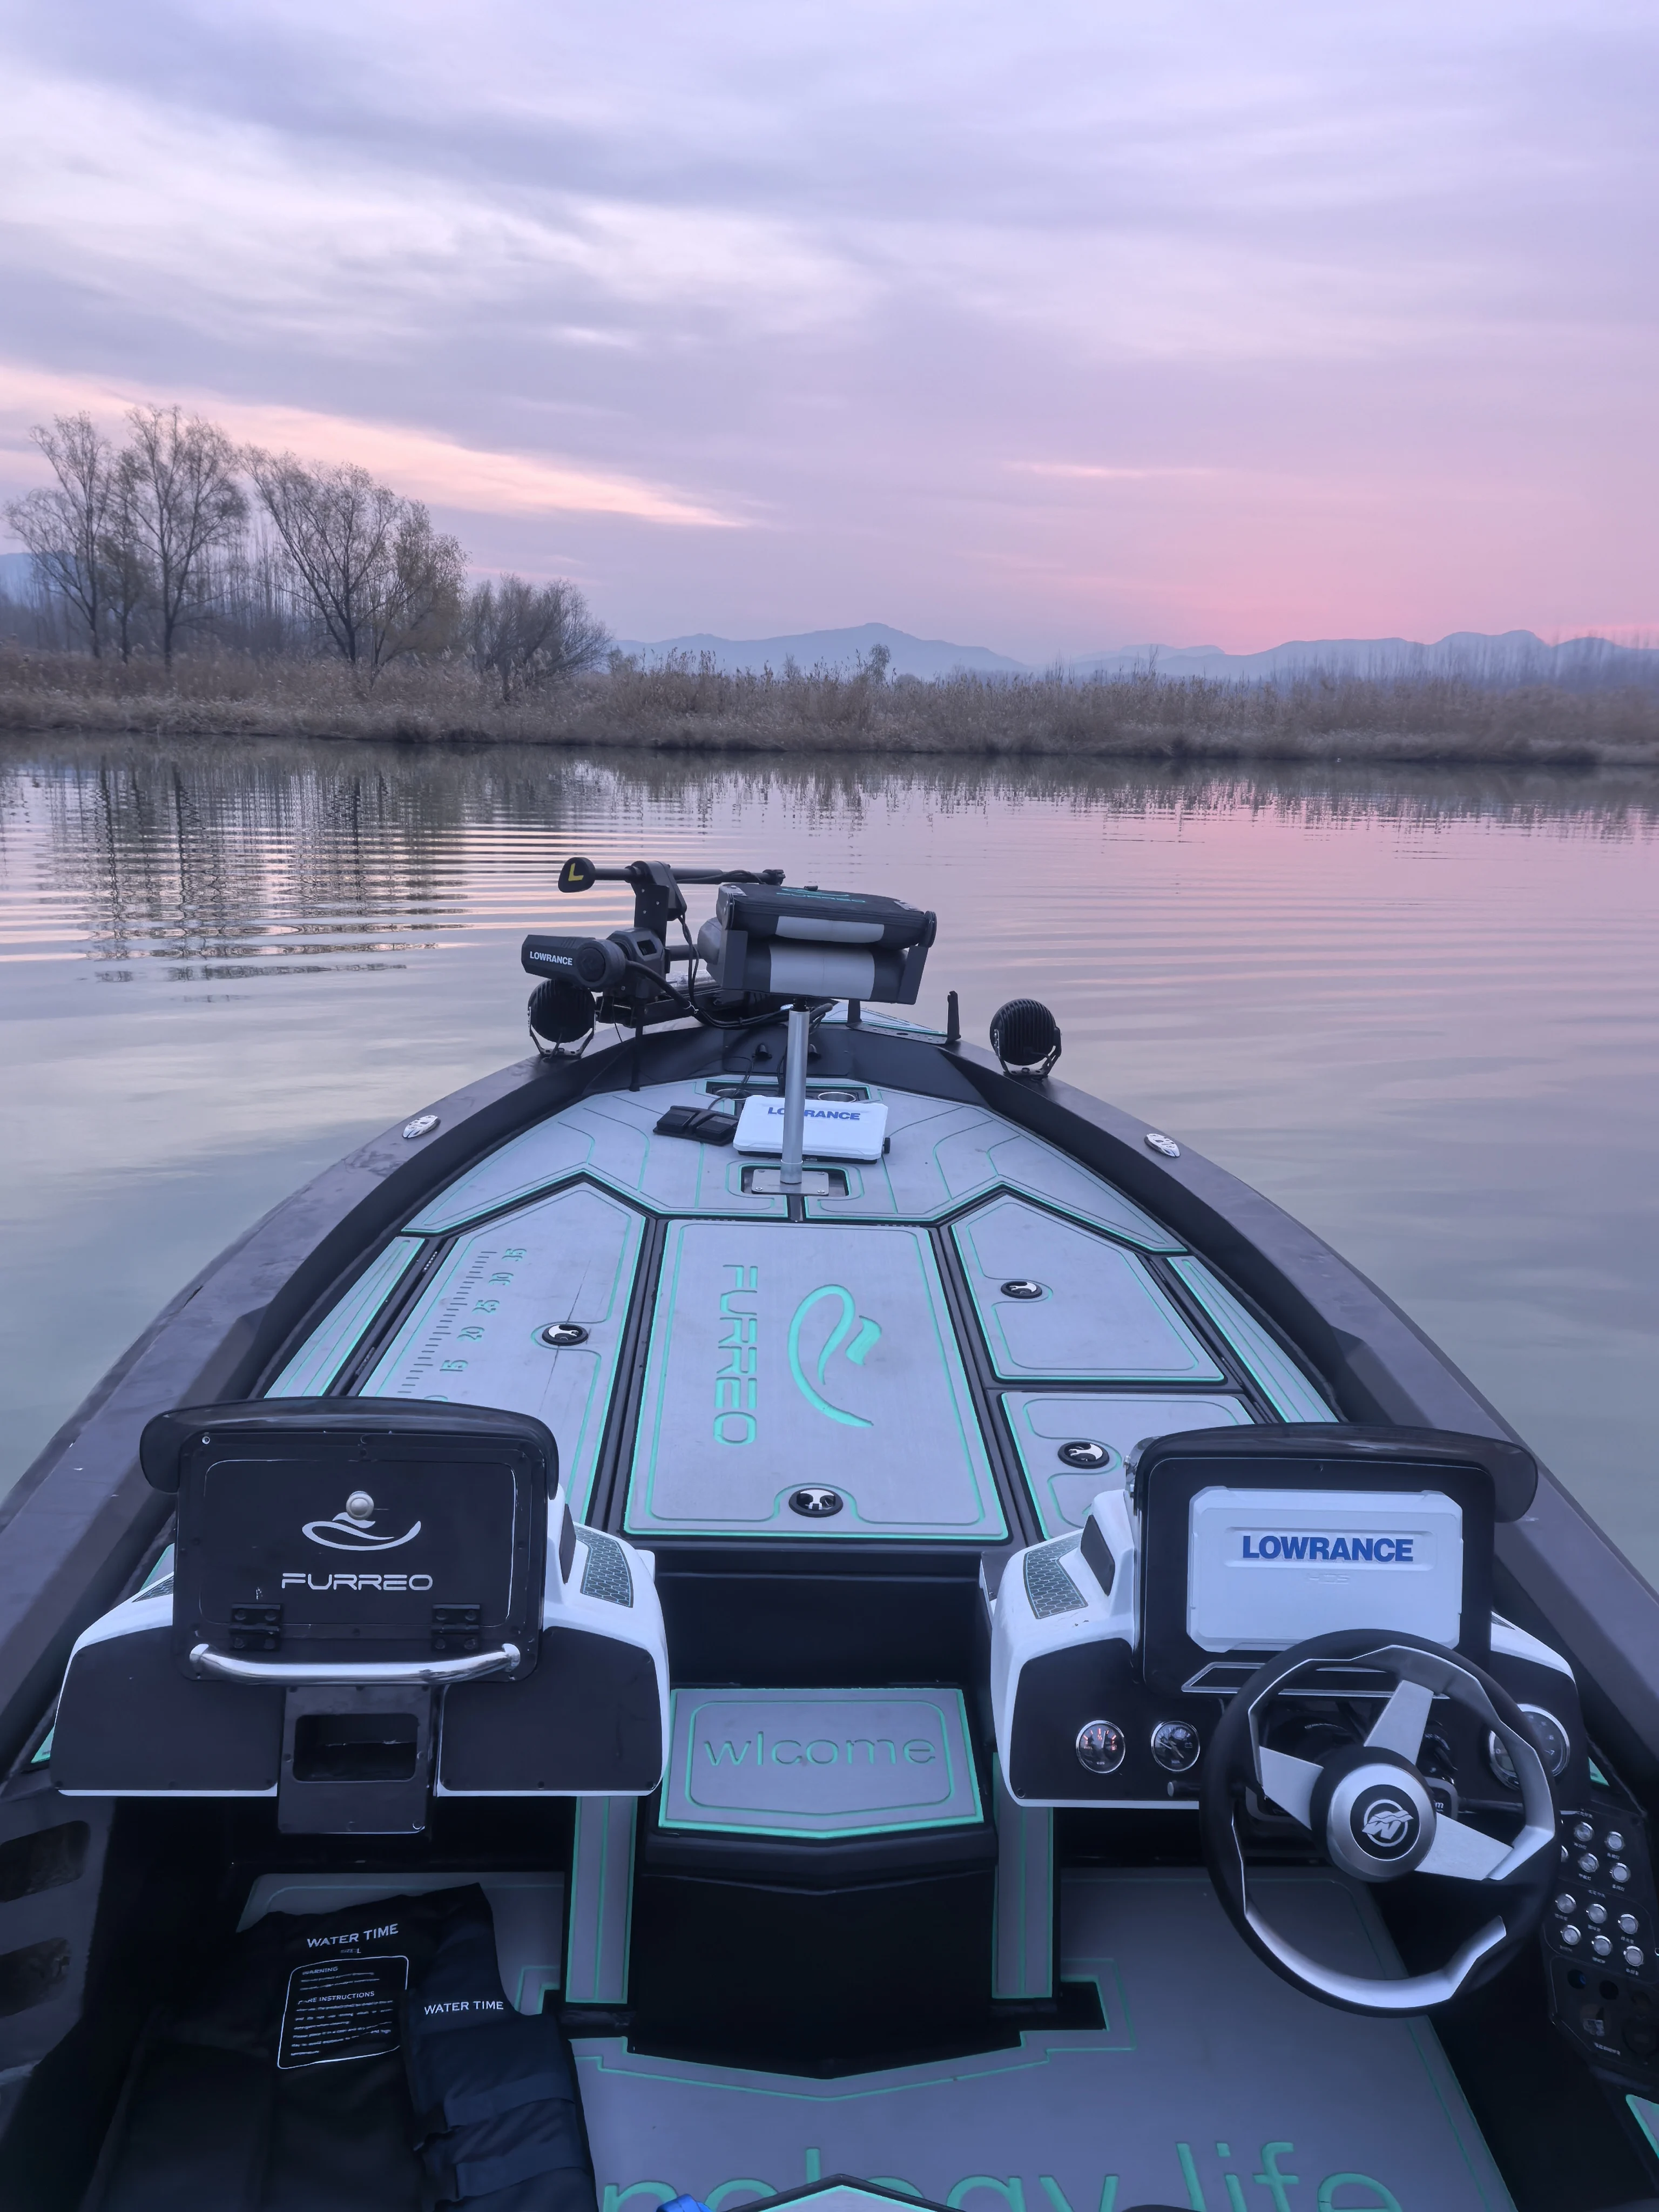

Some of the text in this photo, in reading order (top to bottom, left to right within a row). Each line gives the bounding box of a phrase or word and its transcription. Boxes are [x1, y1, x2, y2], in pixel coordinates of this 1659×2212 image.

[530, 951, 572, 966] LOWRANCE
[768, 1107, 860, 1120] LORANCE
[502, 1249, 527, 1262] 35
[489, 1272, 514, 1285] 30
[472, 1300, 500, 1315] 25
[457, 1326, 485, 1341] 20
[714, 1265, 758, 1445] FURREO
[440, 1360, 468, 1373] 15
[1243, 1535, 1413, 1562] LOWRANCE
[281, 1573, 433, 1591] FURREO
[704, 1731, 935, 1766] wlcome
[307, 1923, 399, 1948] WATER TIME
[320, 1991, 375, 2002] INSTRUCTIONS
[424, 2001, 504, 2015] WATER TIME
